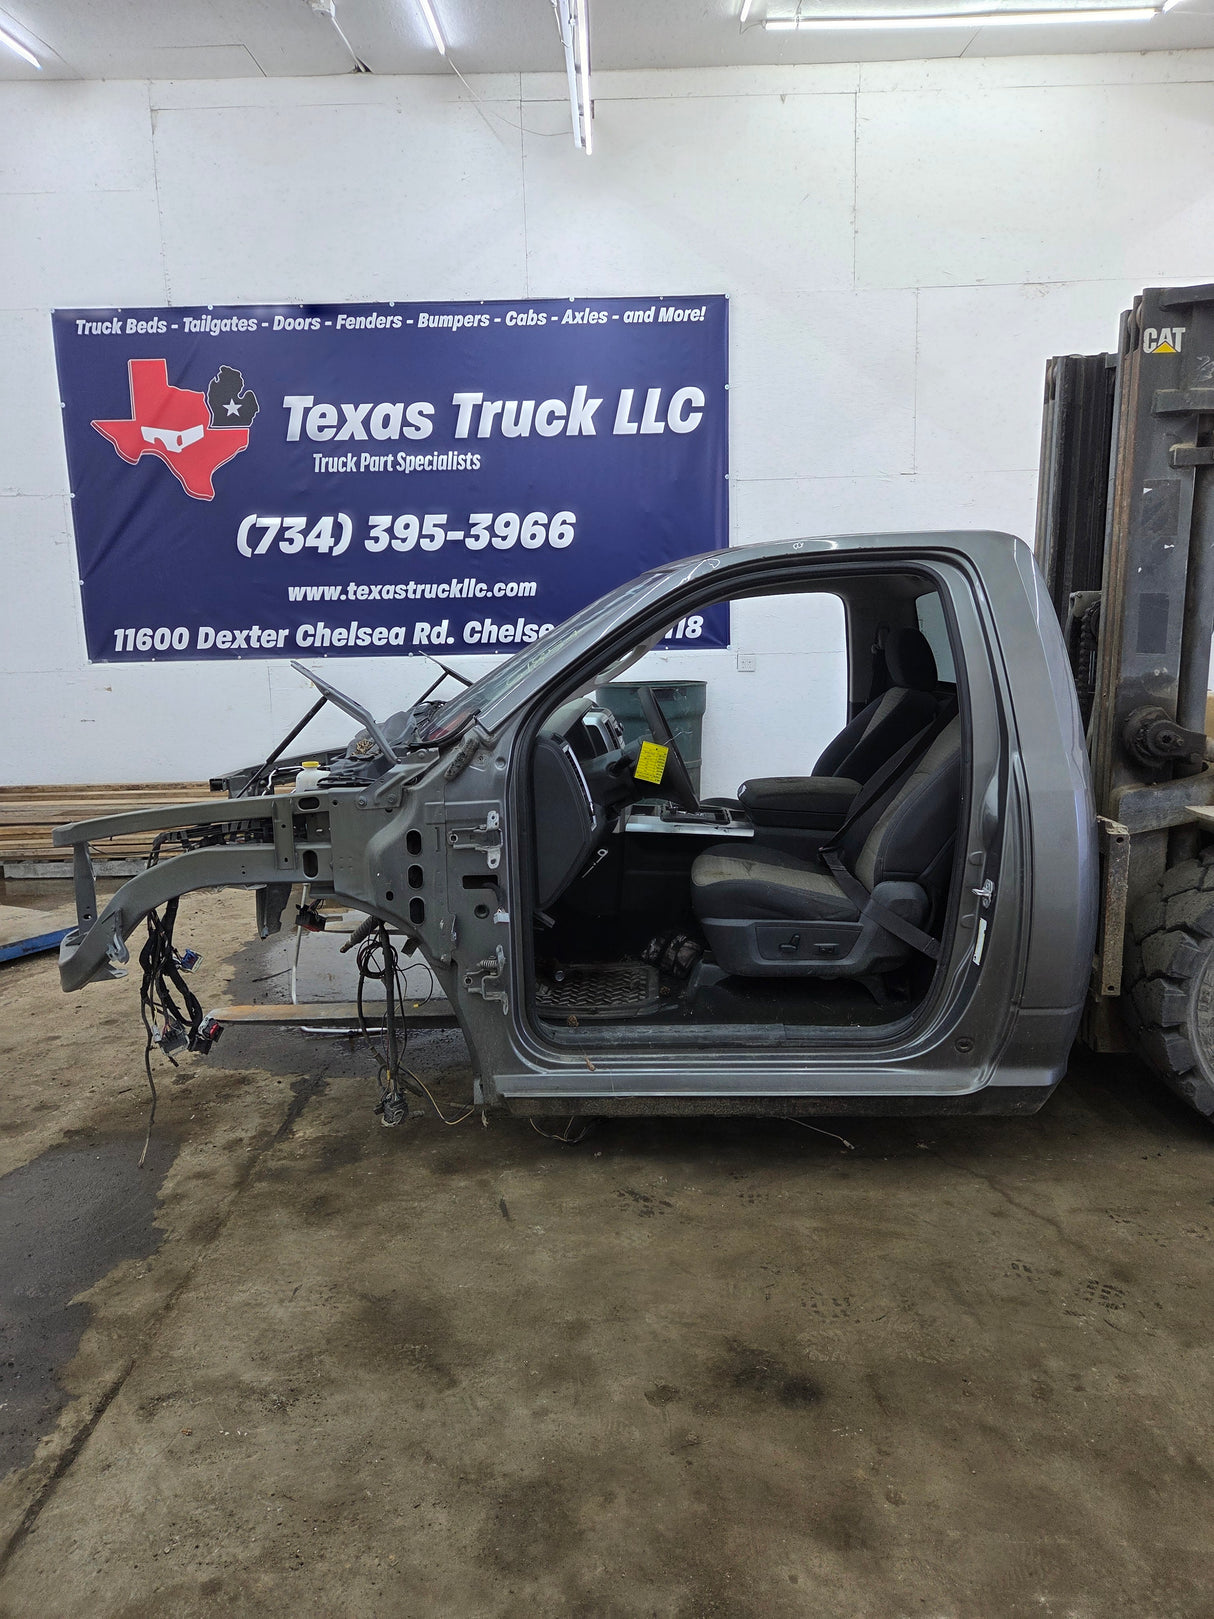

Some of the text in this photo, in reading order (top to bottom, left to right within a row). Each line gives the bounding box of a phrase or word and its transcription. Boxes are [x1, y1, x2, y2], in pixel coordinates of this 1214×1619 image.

[76, 318, 122, 334] Truck
[126, 317, 167, 333] Beds
[183, 315, 257, 336] Tailgates
[273, 316, 321, 330] Doors
[336, 313, 402, 329] Fenders
[418, 313, 490, 331] Bumpers
[506, 309, 547, 326] Cabs
[561, 308, 608, 324] Axles
[624, 306, 656, 323] and
[658, 306, 706, 322] More!
[1143, 327, 1186, 354] CAT
[283, 385, 705, 441] Texas Truck LLC
[313, 451, 481, 473] Truck Part Specialists
[237, 511, 576, 557] (734) 395-3966
[288, 579, 536, 601] www.texastruckllc.com
[114, 627, 189, 651] 11600
[197, 626, 289, 649] Dexter
[296, 622, 405, 647] Chelsea
[413, 620, 454, 644] Rd.
